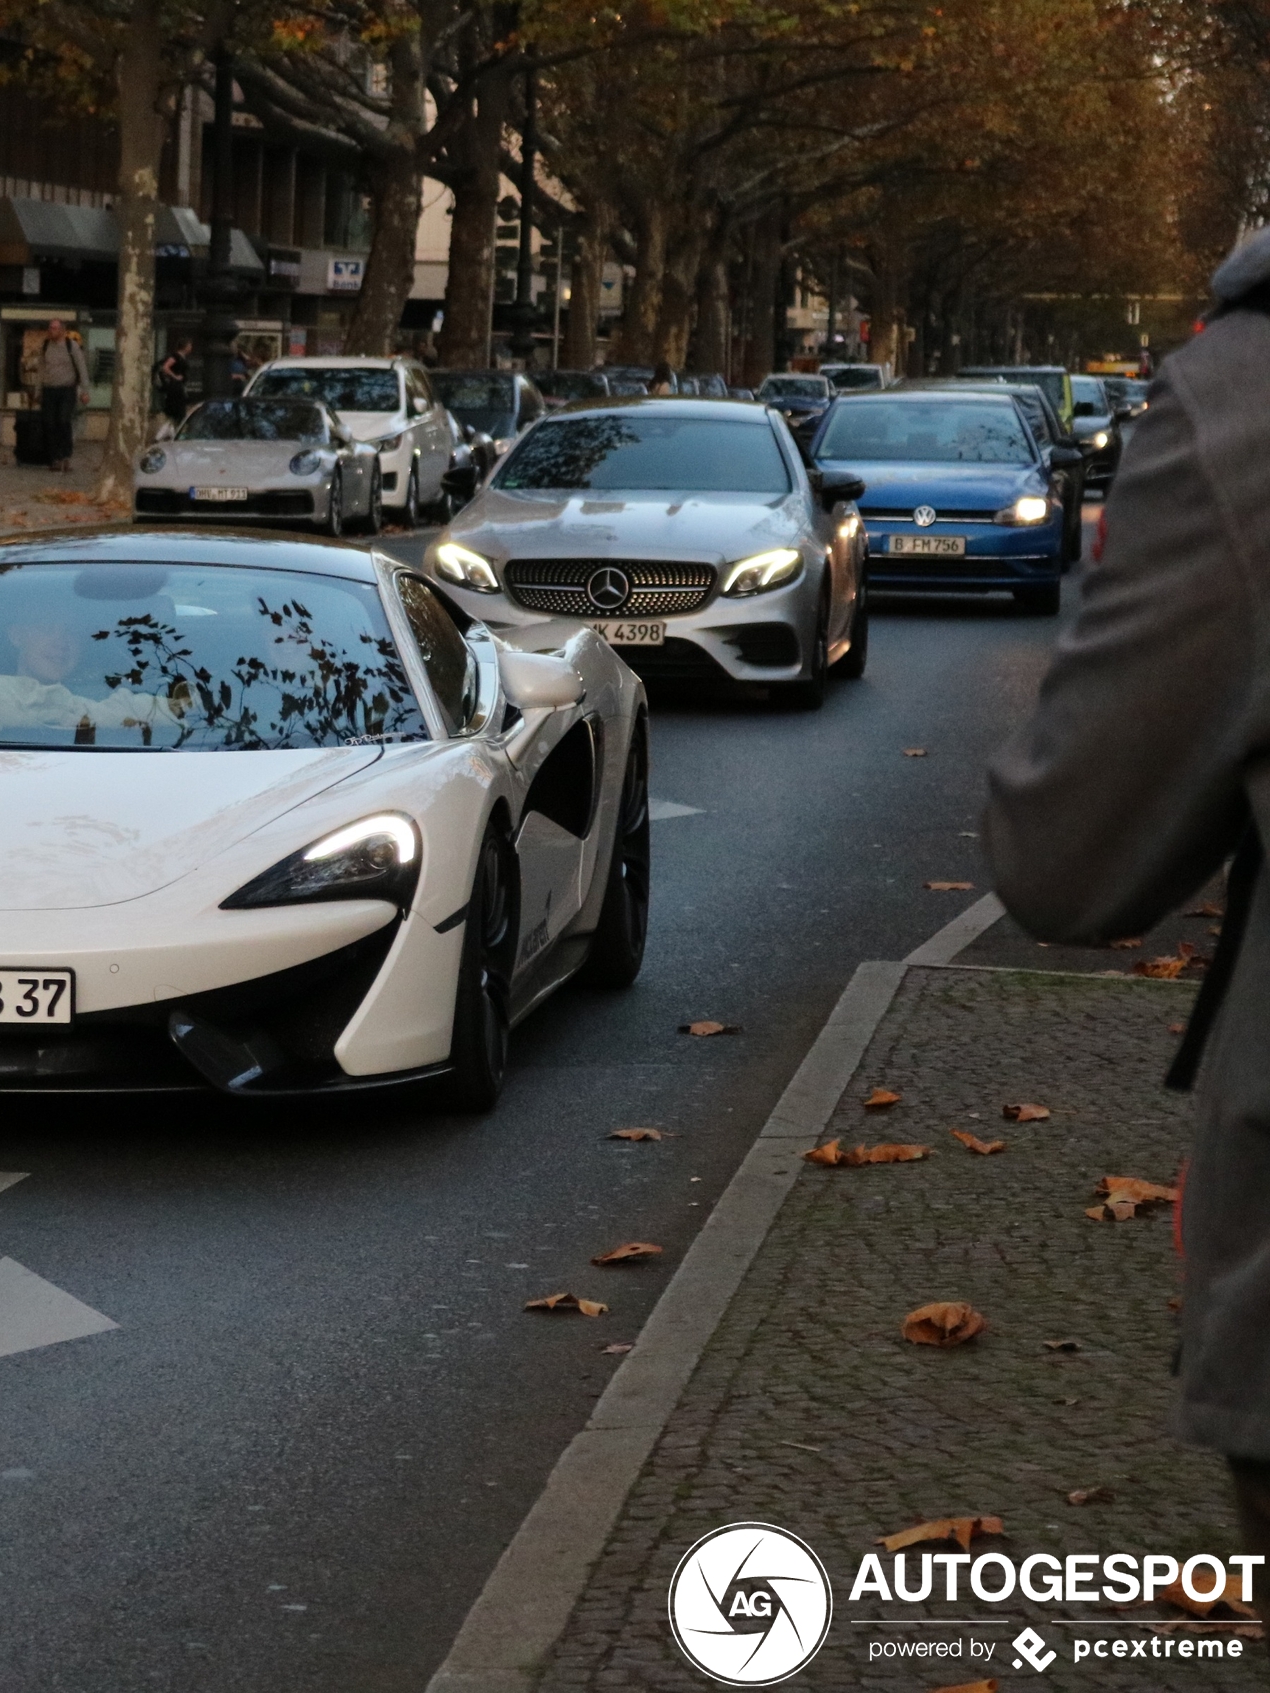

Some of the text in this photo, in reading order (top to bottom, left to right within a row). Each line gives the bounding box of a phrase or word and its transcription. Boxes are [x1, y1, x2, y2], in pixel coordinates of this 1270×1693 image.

[895, 538, 959, 552] B FM 756
[614, 623, 660, 641] 4398
[16, 978, 67, 1018] 37
